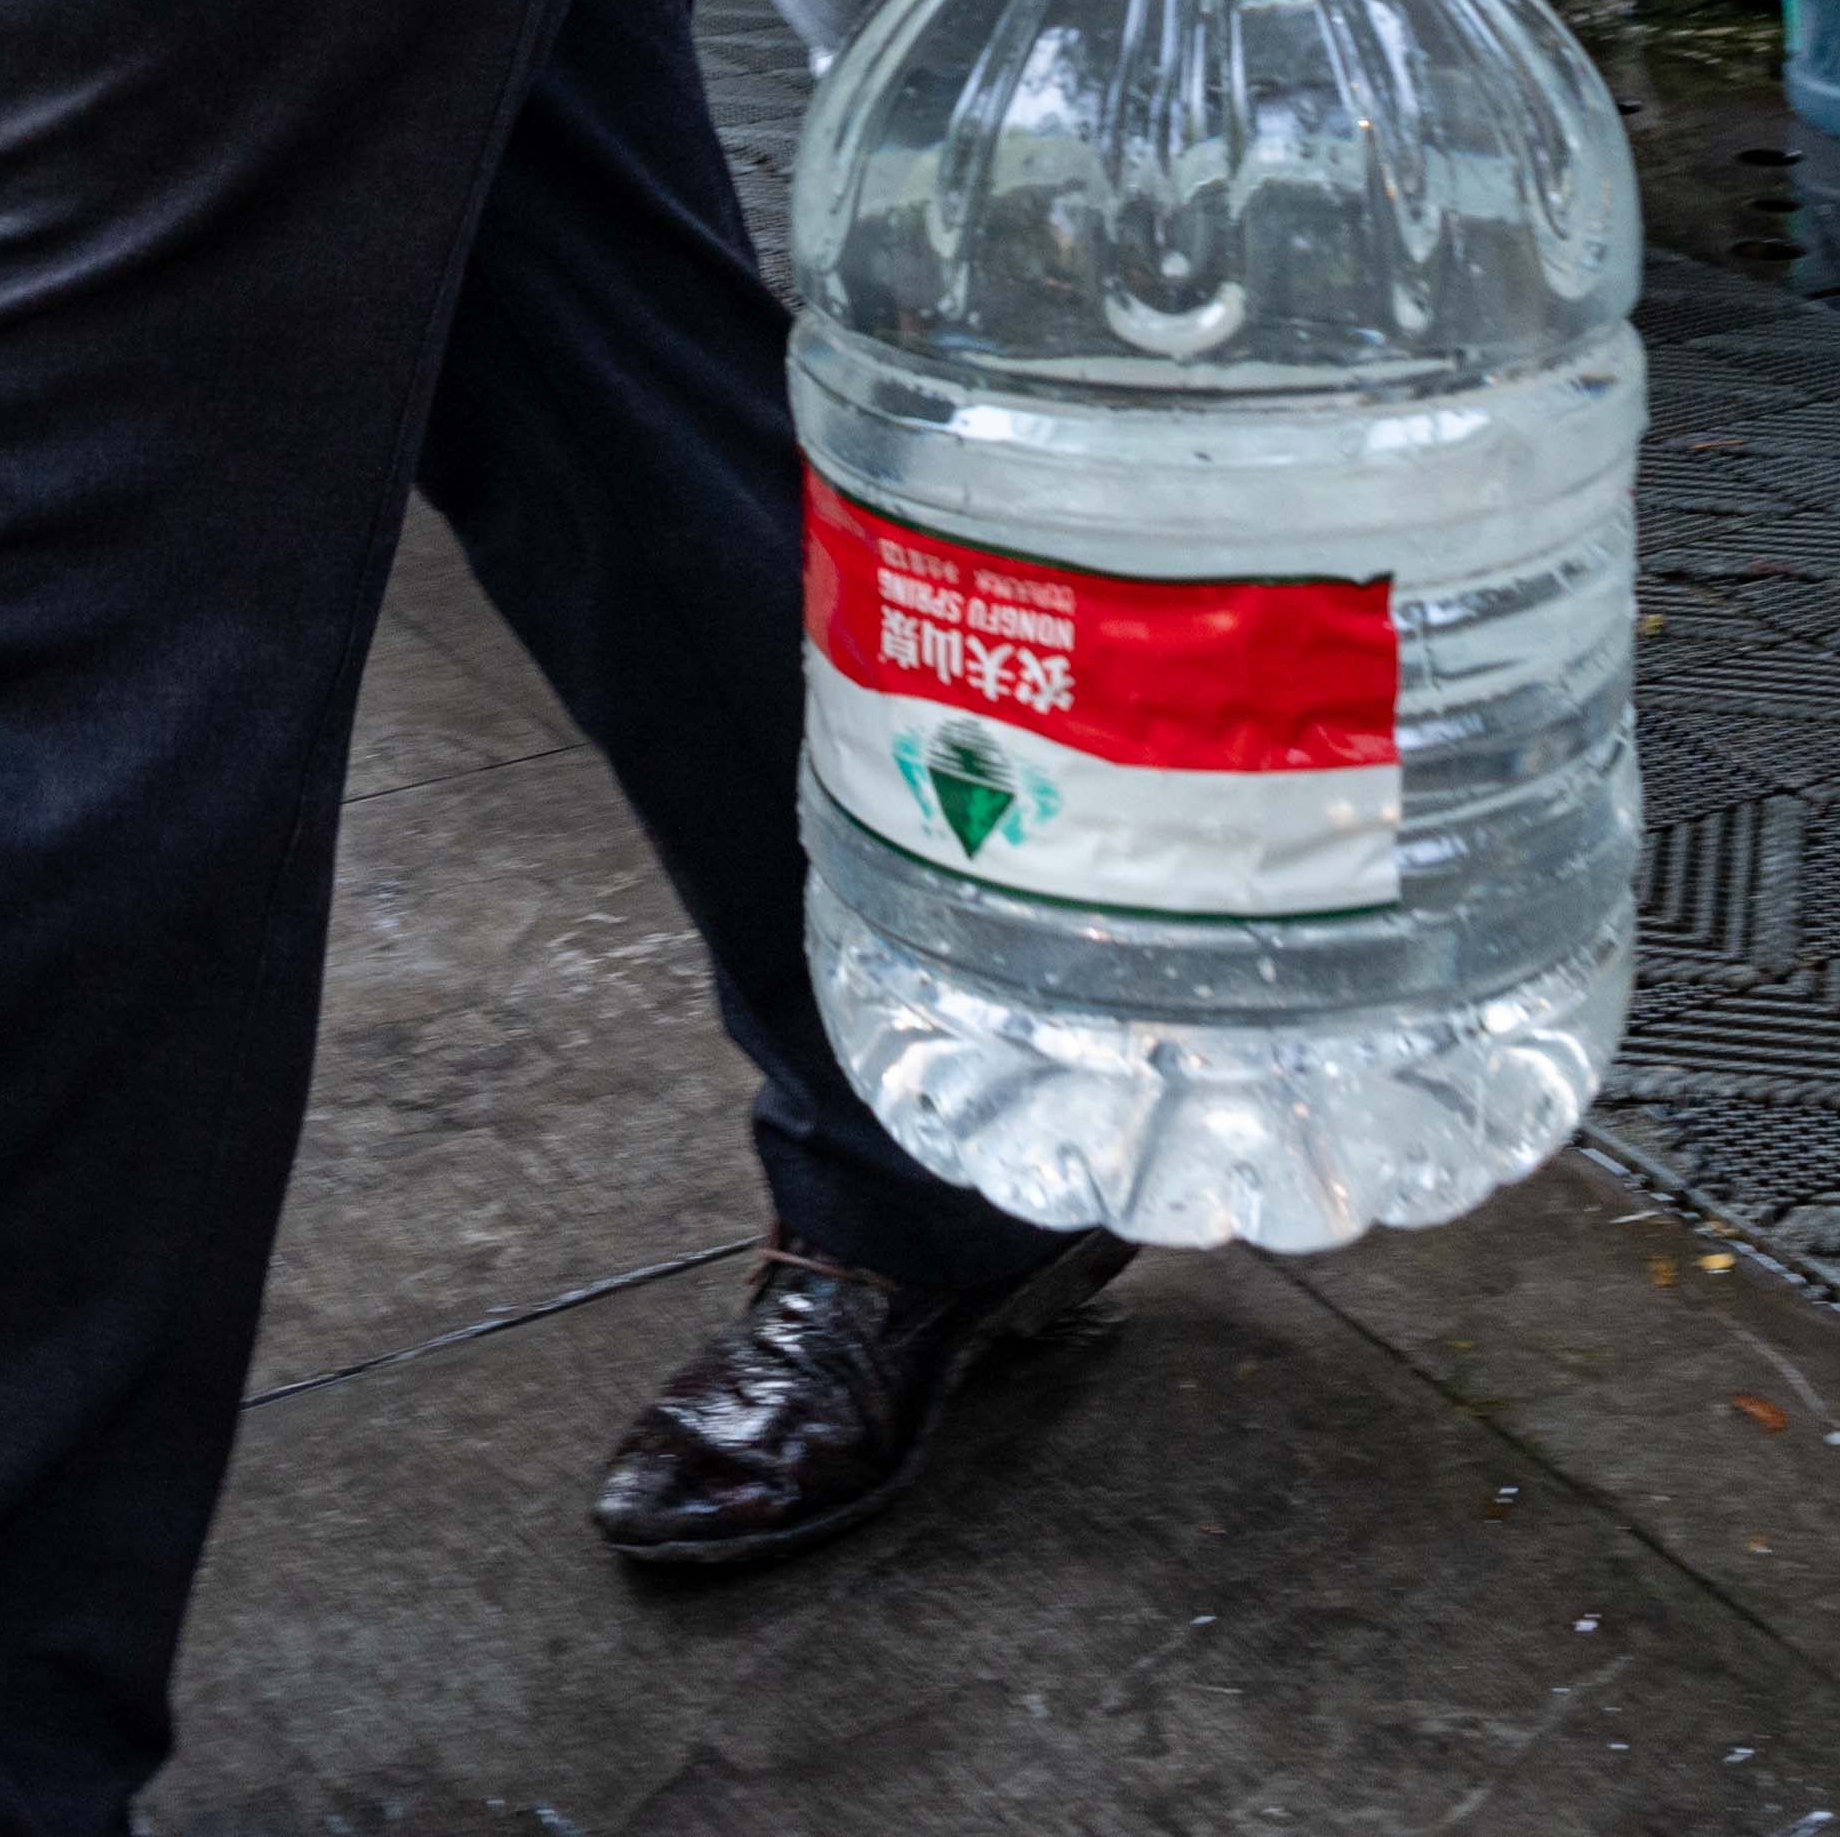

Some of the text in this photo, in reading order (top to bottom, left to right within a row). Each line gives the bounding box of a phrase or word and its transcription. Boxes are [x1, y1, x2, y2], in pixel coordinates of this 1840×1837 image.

[878, 567, 965, 624] SPRING
[966, 597, 1075, 651] NONGFU
[880, 605, 1076, 715] 农夫山泉
